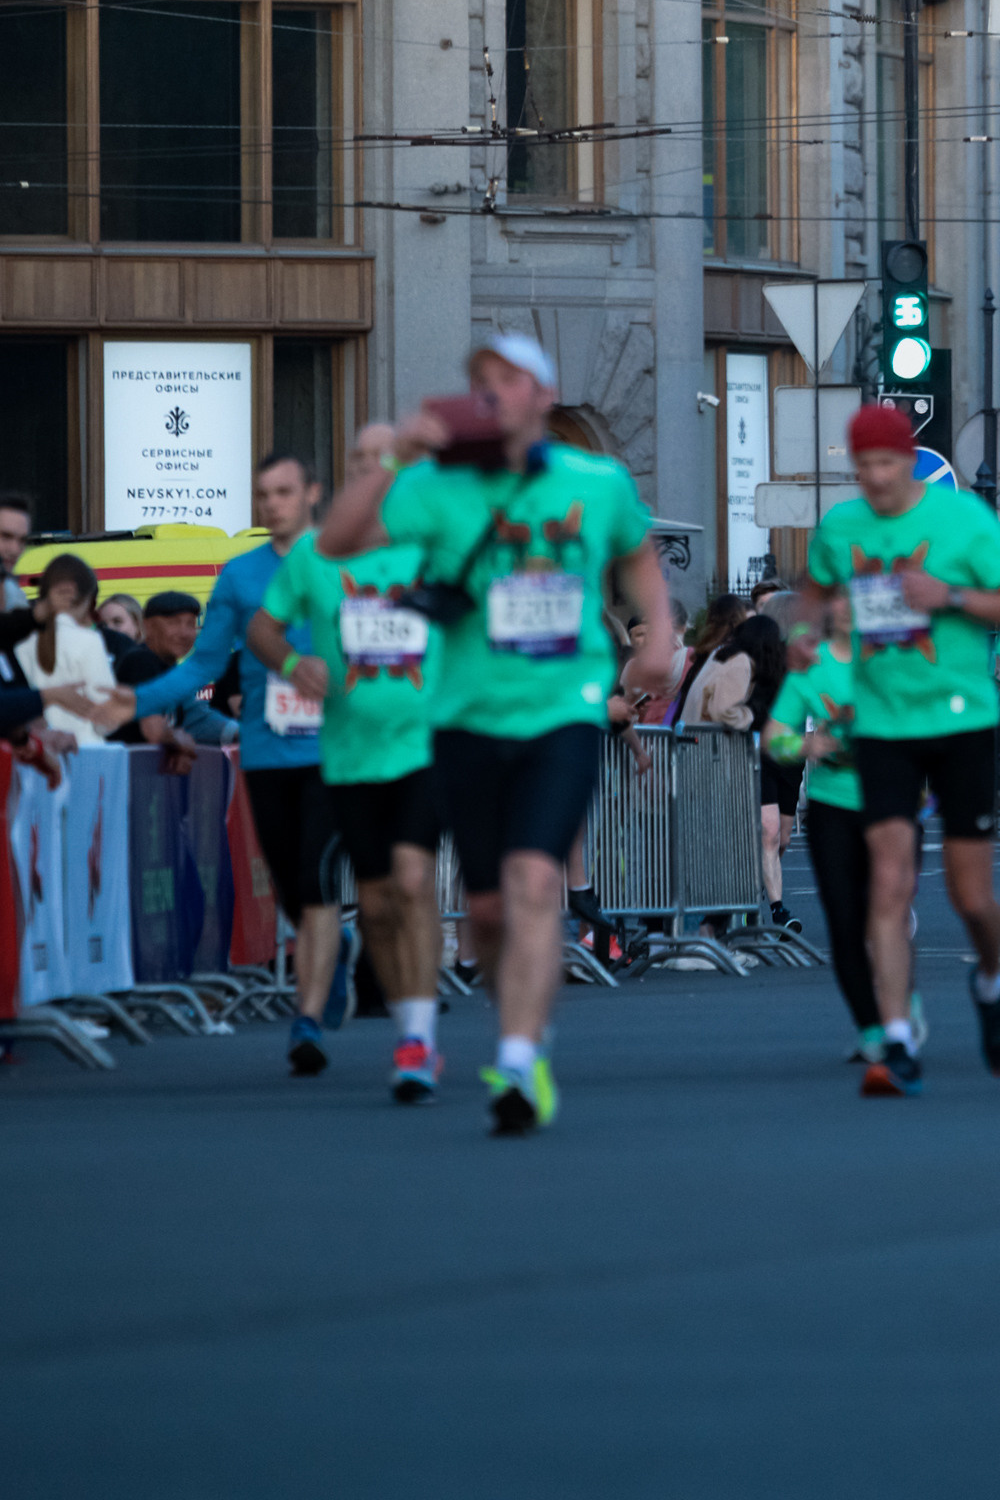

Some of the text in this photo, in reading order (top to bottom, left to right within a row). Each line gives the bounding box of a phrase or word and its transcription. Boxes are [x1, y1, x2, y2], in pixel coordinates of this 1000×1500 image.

[112, 370, 242, 381] ПРЕДСТАВИТЕЛЬСКИЕ
[155, 383, 199, 393] ОФИСЫ
[141, 449, 213, 458] СЕРВИСНЫЕ
[155, 461, 200, 471] ОФИСЫ
[127, 488, 227, 499] NEVSKY1.COM
[141, 506, 213, 517] 777-77-04
